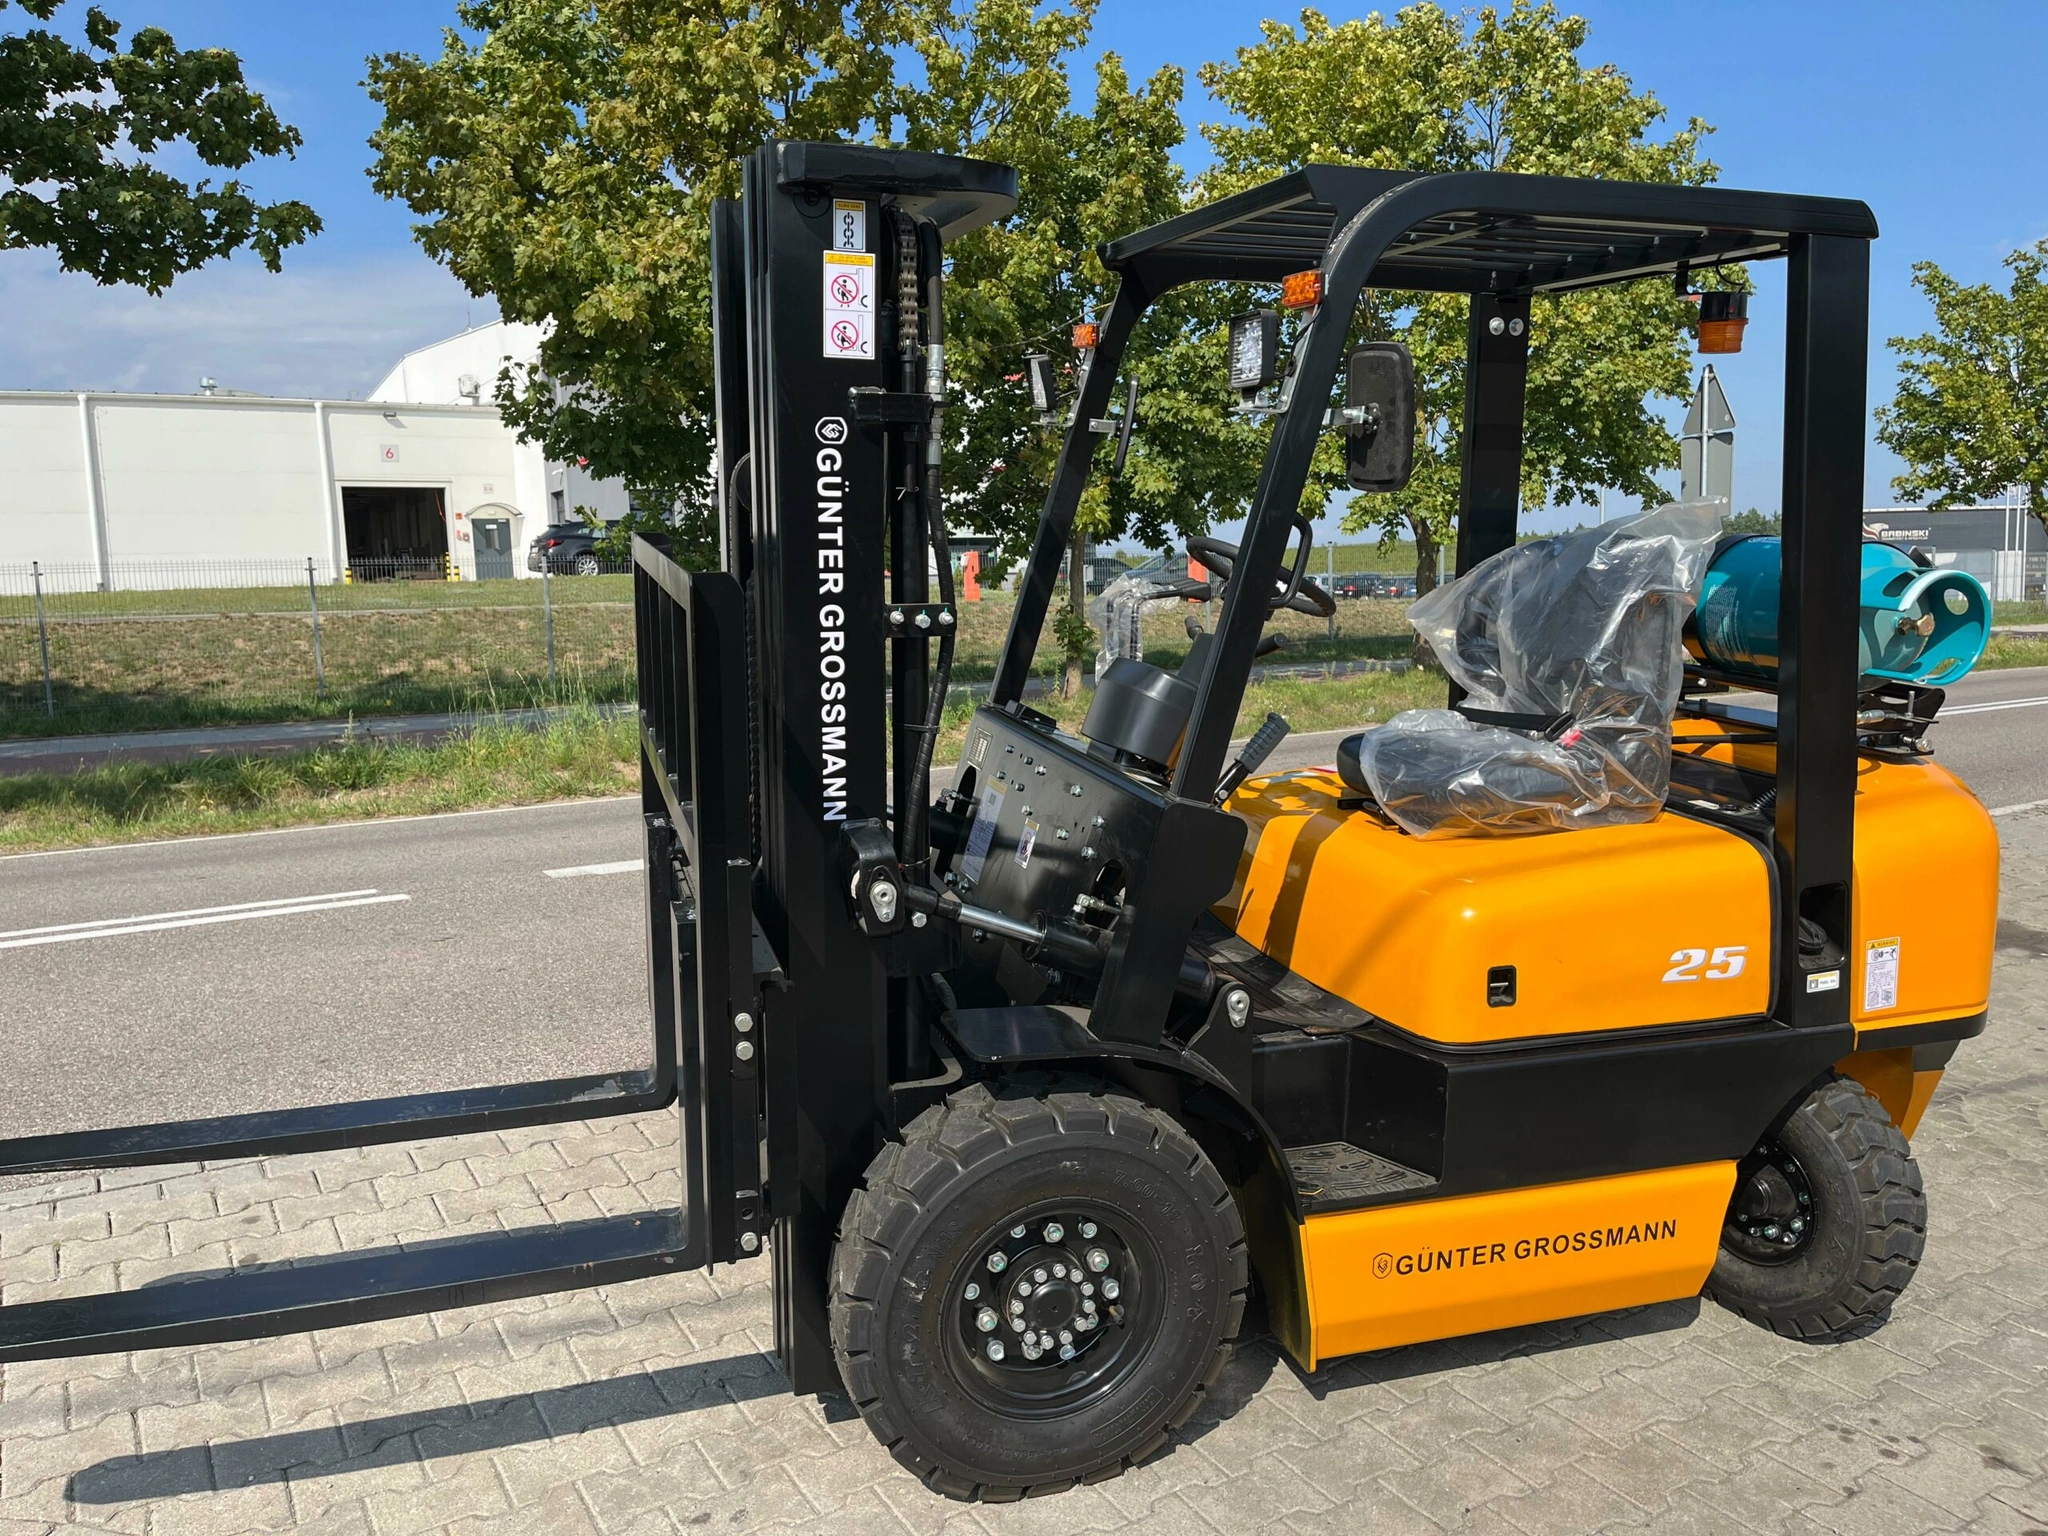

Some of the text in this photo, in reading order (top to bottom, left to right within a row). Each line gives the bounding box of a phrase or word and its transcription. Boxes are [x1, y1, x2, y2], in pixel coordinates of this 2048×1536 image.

[385, 447, 395, 460] 6
[816, 448, 850, 821] GÜNTER GROSSMANN
[1661, 945, 1749, 984] 25
[1395, 1219, 1678, 1276] GÜNTER GROSSMANN
